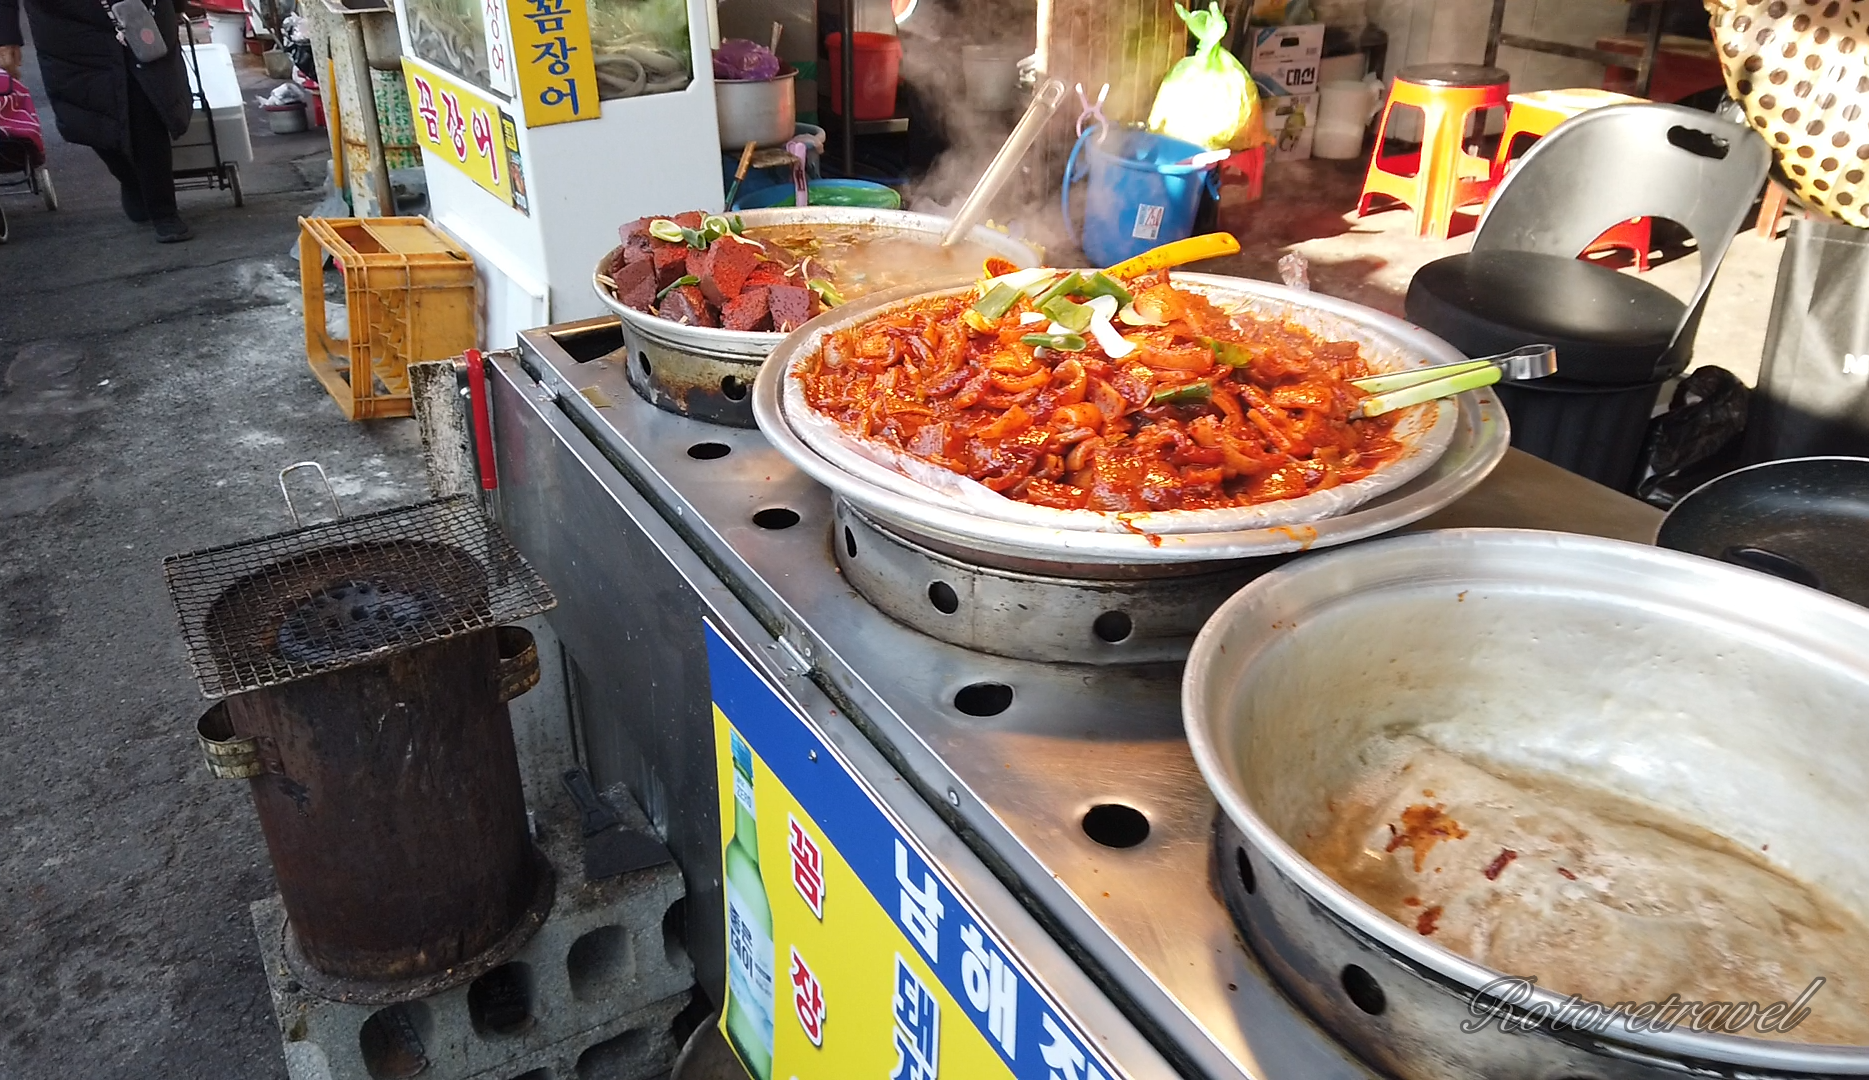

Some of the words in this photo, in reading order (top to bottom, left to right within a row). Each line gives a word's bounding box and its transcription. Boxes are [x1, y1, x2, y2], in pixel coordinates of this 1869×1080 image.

[1286, 67, 1315, 86] 대선
[414, 77, 499, 185] 꼼장어
[730, 901, 753, 955] 좋은
[730, 926, 753, 979] 데이
[788, 812, 824, 1080] 꼼장
